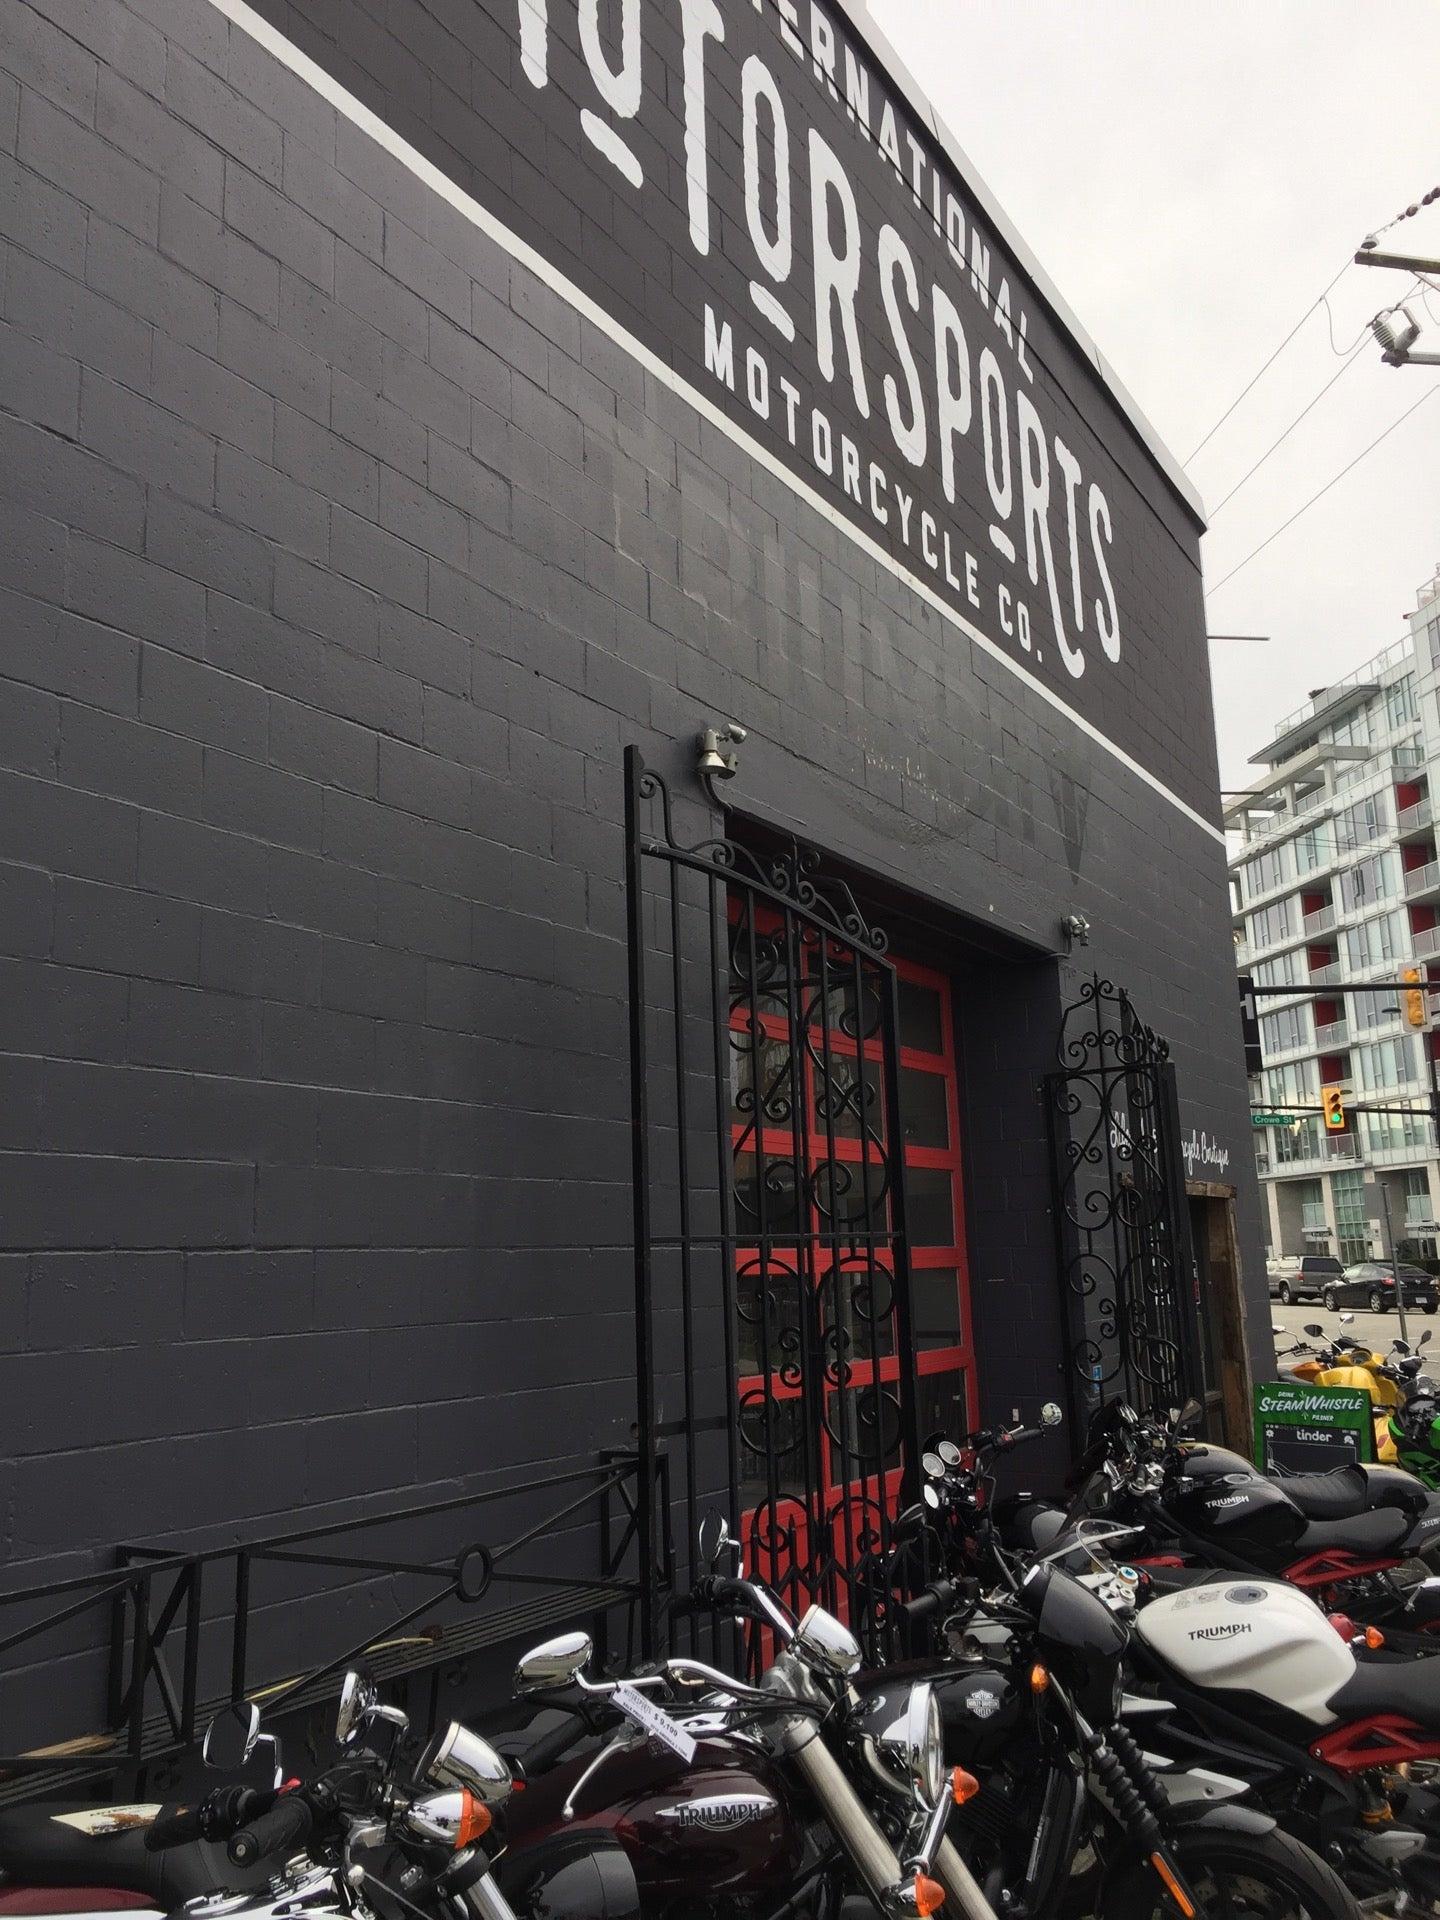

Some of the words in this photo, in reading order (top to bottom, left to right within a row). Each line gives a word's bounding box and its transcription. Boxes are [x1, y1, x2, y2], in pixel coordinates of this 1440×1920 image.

[753, 0, 1033, 384] ERNATIONAL
[518, 0, 1121, 679] TORSPORTS
[704, 303, 981, 609] MOTORCYCLE
[998, 583, 1043, 663] CO.
[1254, 1115, 1280, 1124] Crowe
[1296, 1429, 1333, 1443] tinder
[1204, 1495, 1250, 1509] TRIUMPH
[1188, 1623, 1253, 1641] TRIUMPH
[674, 1803, 762, 1832] TRIUMPH
